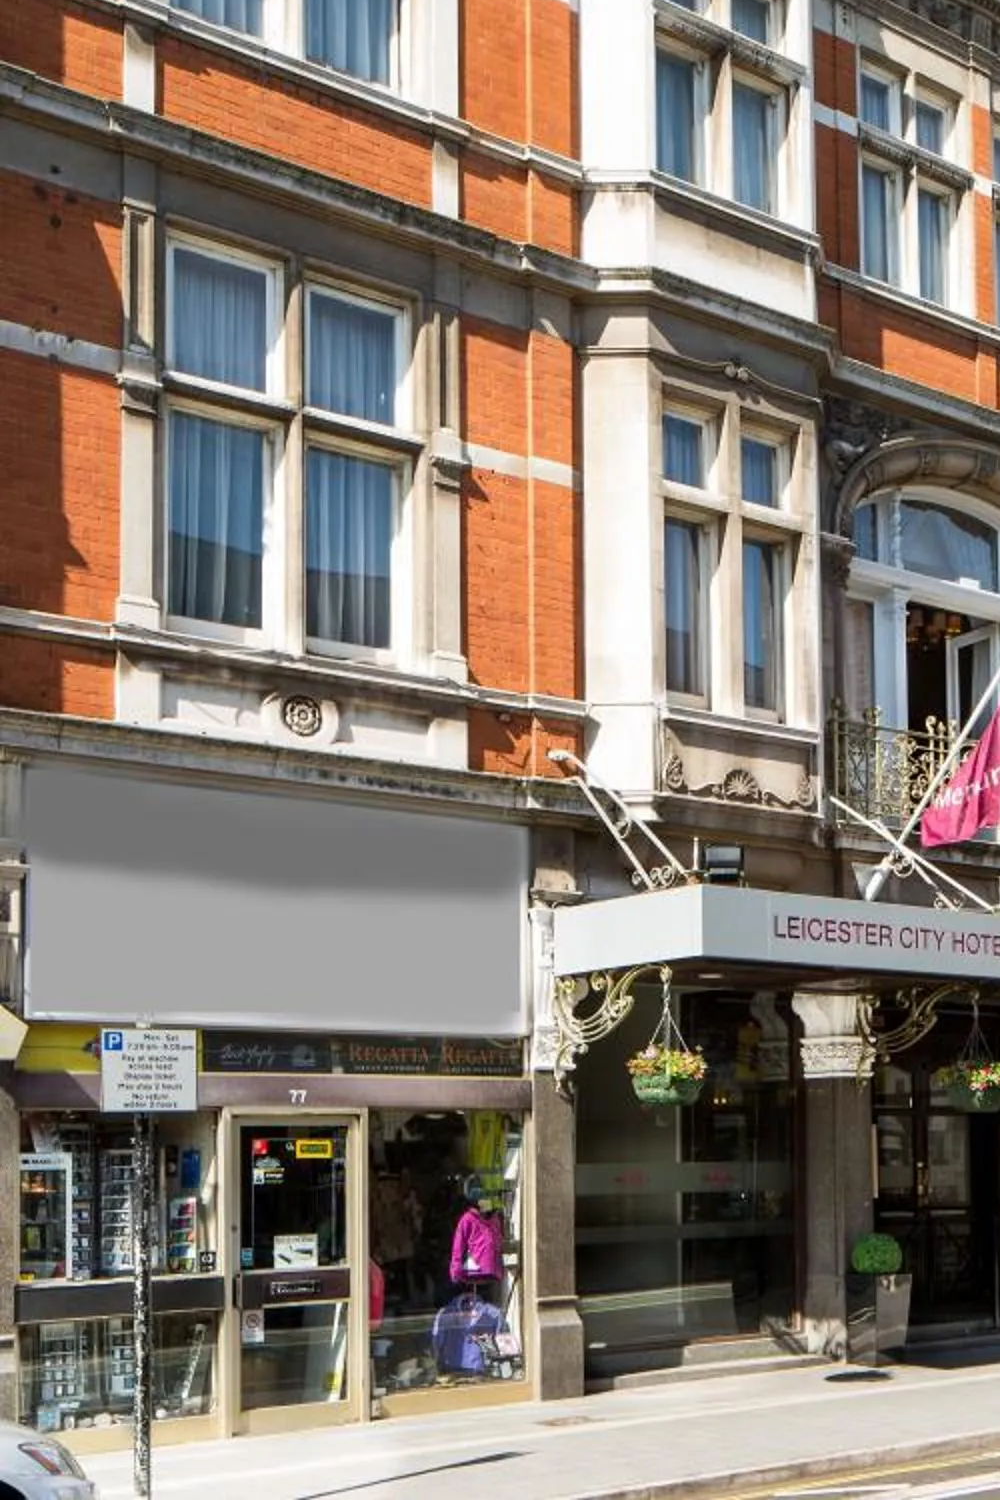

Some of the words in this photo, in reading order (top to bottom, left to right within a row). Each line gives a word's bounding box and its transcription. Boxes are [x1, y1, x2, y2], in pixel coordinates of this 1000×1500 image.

[773, 915, 893, 947] LEICESTER
[899, 927, 945, 951] CITY
[108, 1033, 121, 1049] P
[288, 1089, 308, 1103] 77
